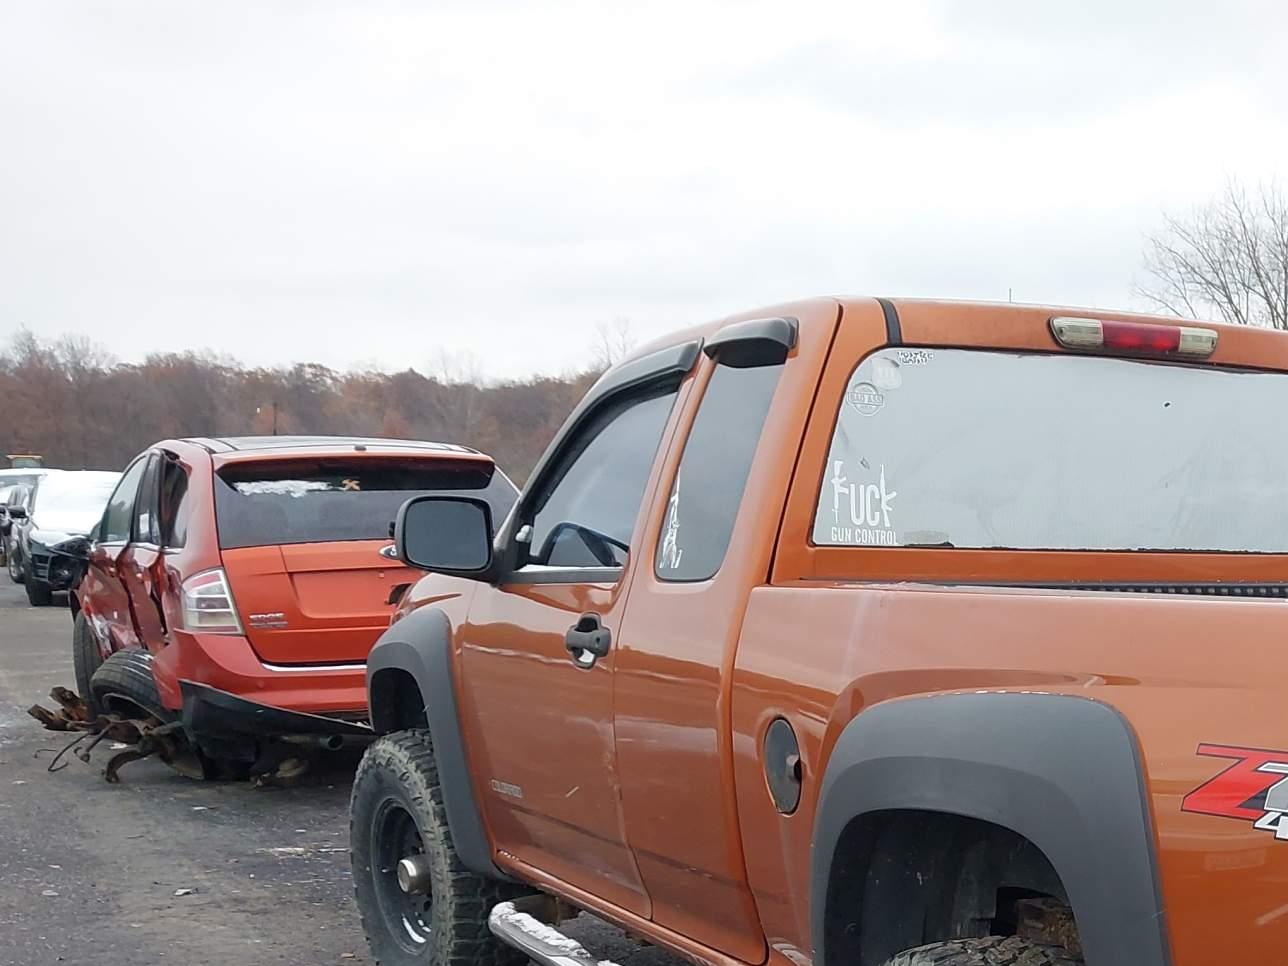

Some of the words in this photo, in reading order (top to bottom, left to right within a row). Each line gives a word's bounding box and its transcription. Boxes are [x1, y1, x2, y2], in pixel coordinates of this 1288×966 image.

[831, 461, 897, 528] FUCK
[831, 526, 852, 543] GUN
[854, 528, 898, 545] CONTROL
